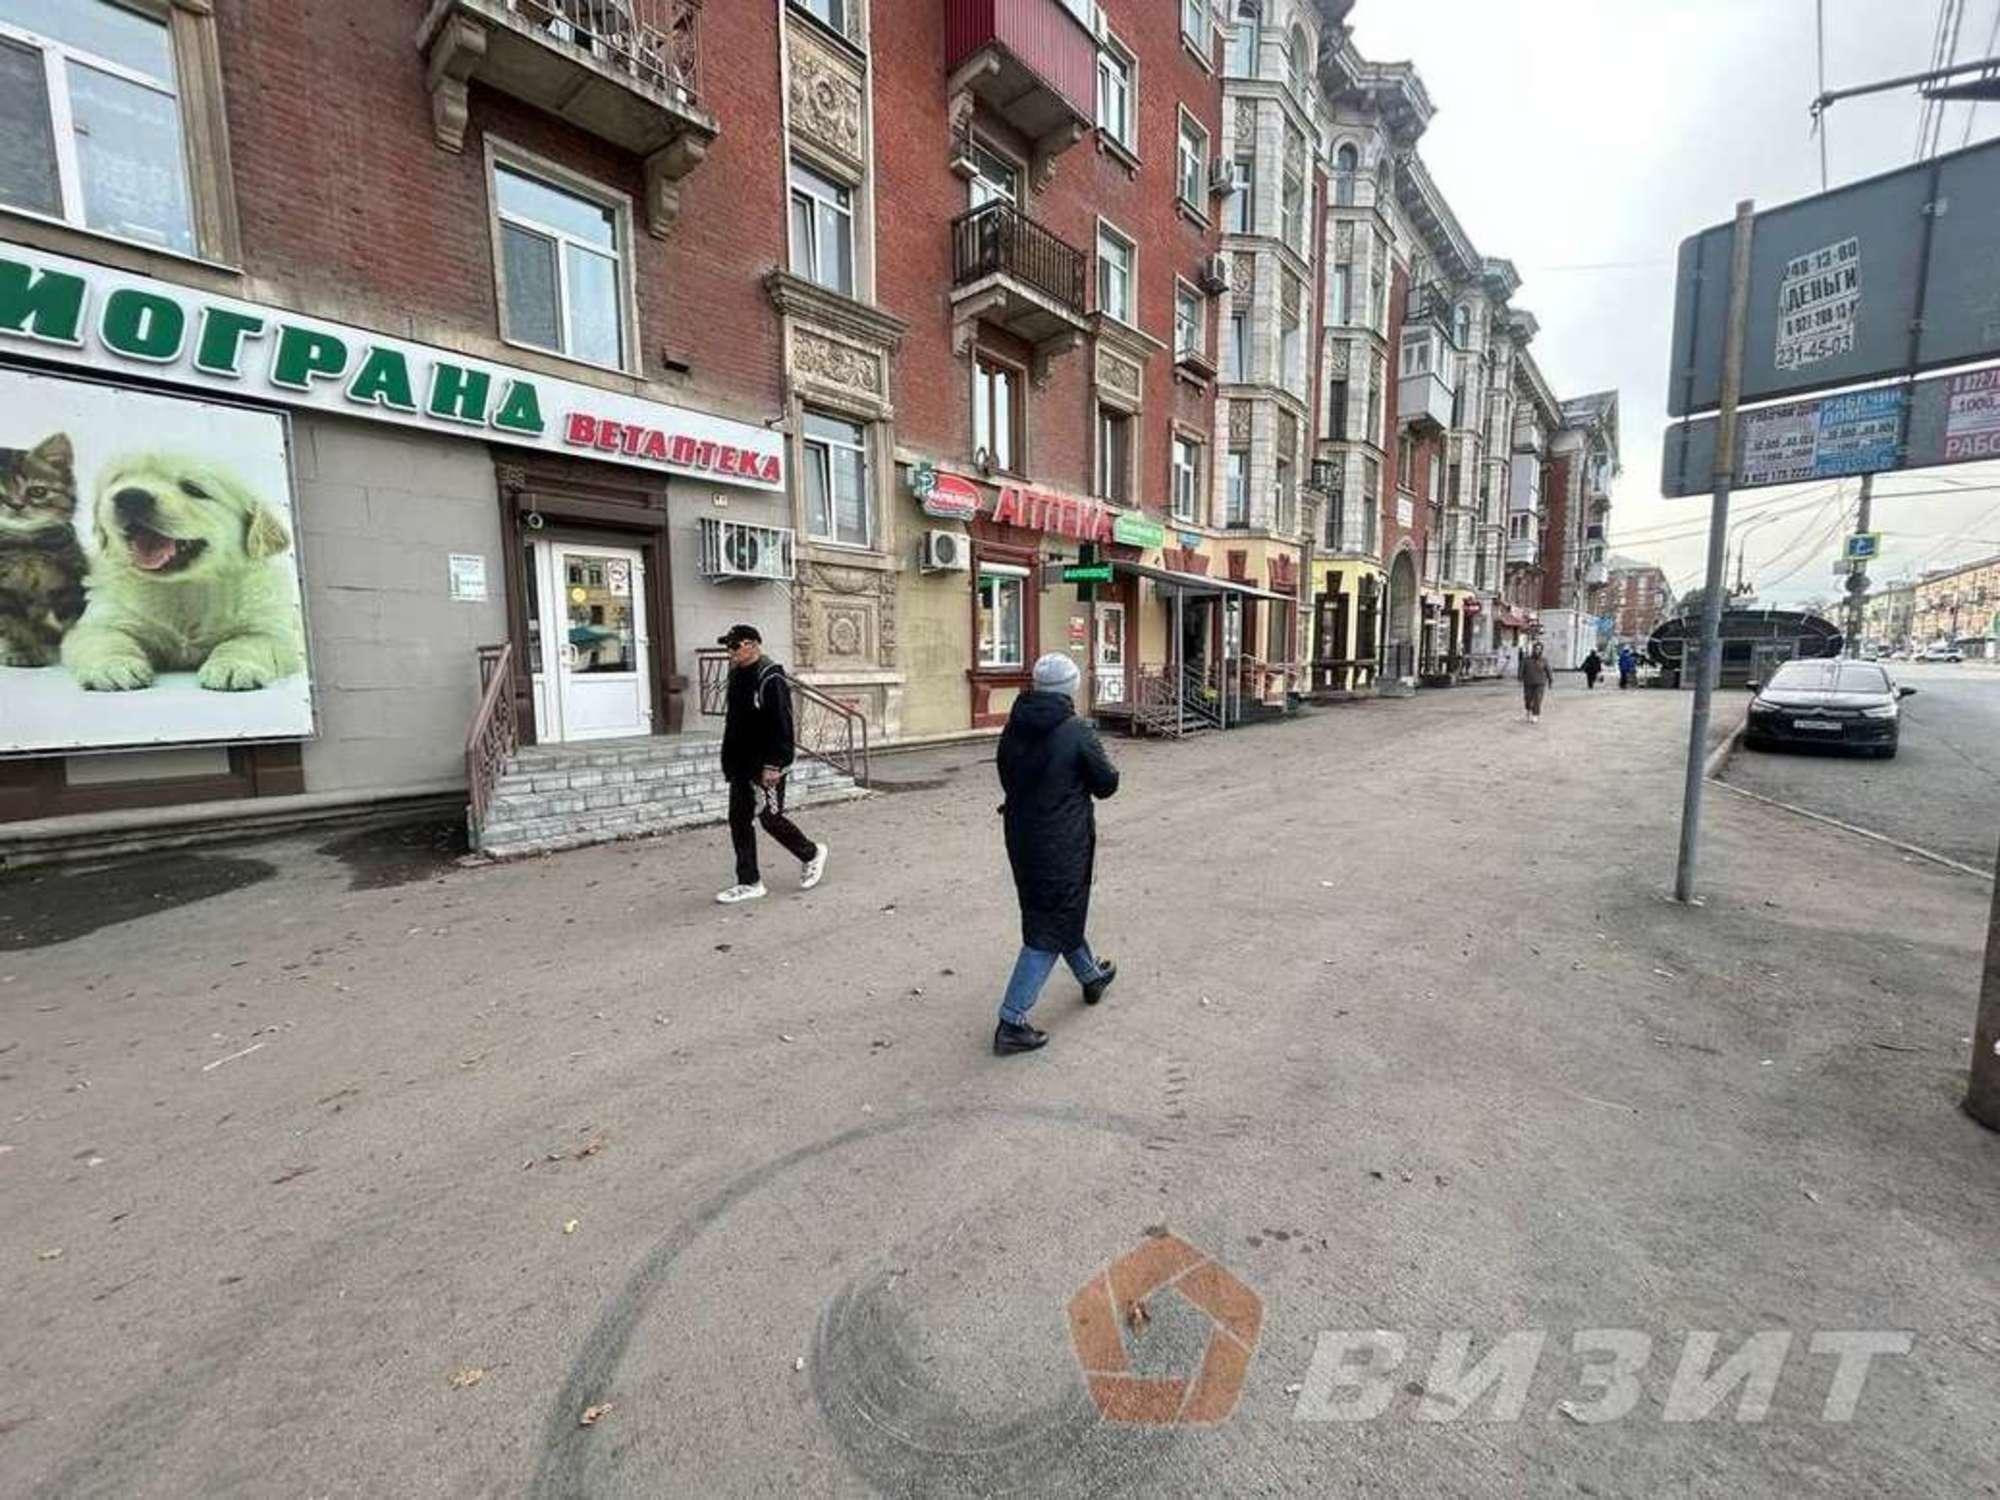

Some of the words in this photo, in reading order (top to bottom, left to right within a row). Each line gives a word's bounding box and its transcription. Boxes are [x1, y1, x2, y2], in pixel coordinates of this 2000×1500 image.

[1785, 266, 1857, 312] ДЕНЬГИ
[566, 413, 782, 484] ВЕТАПТЕКА
[992, 487, 1114, 544] АПТЕКА
